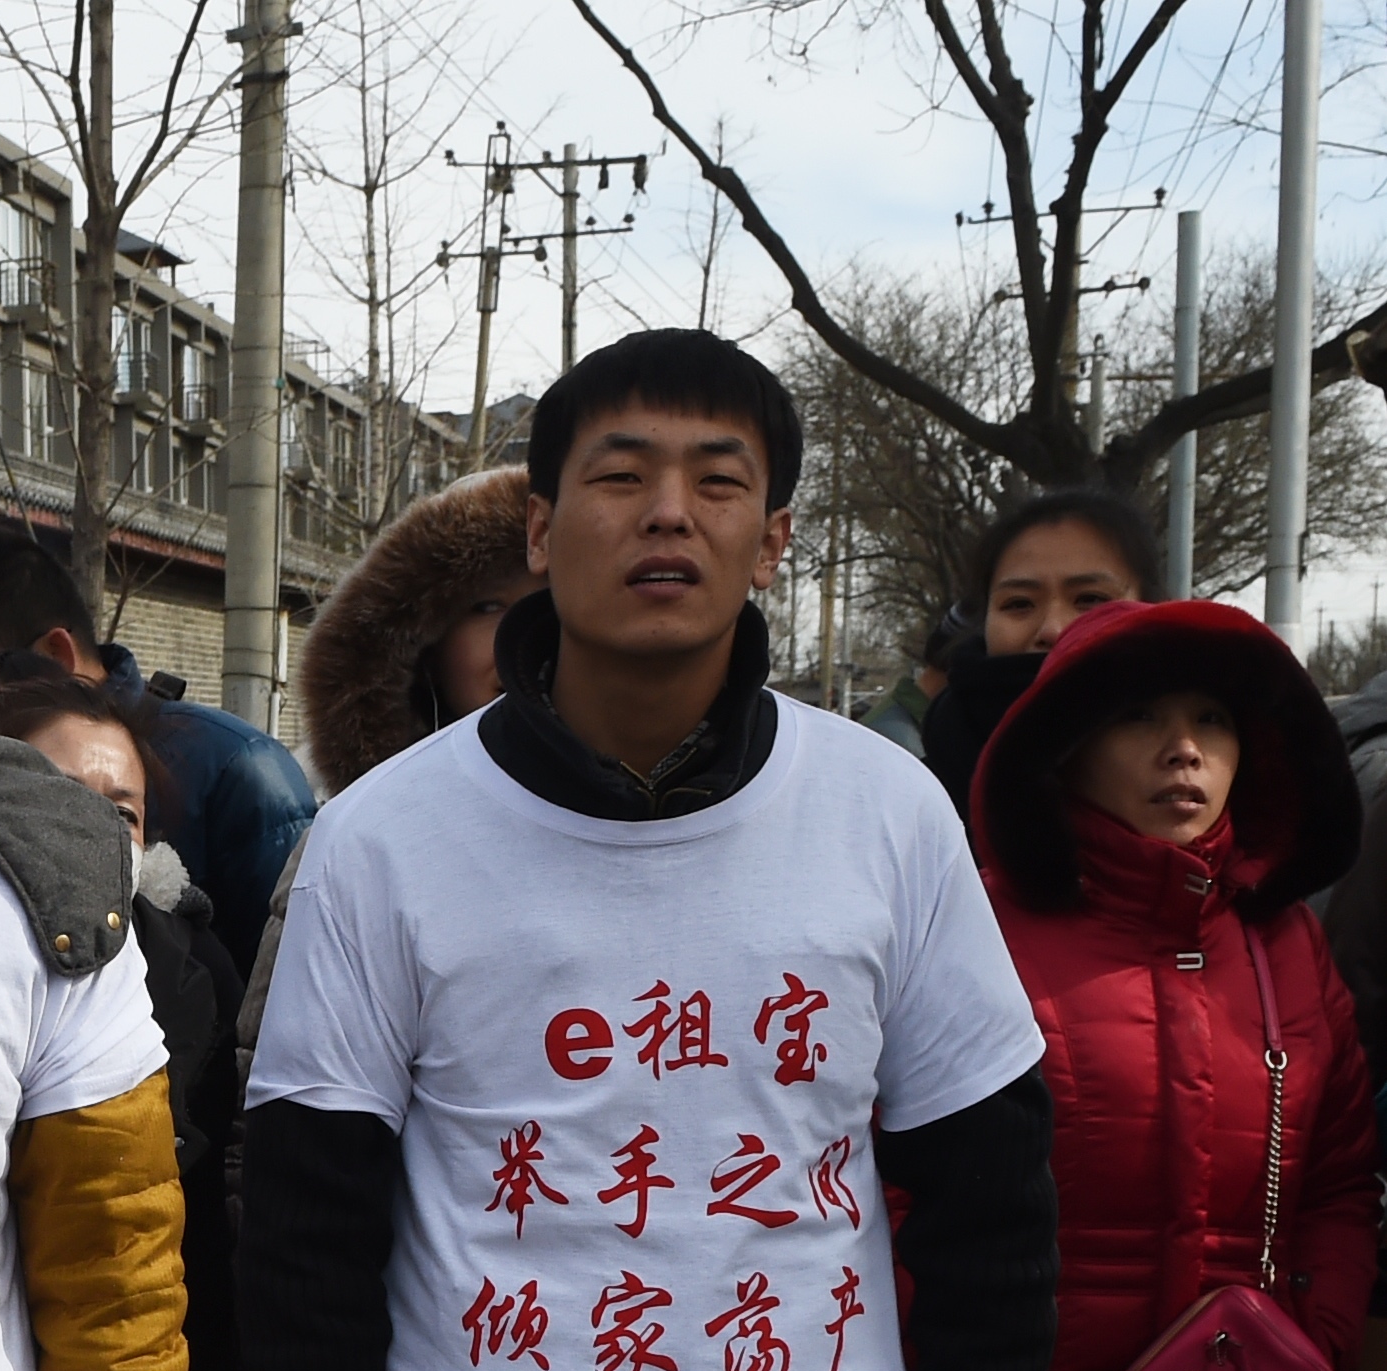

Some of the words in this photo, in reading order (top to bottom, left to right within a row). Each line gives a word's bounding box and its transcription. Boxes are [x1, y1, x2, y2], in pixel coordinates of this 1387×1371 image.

[543, 972, 829, 1086] e租宝
[483, 1120, 861, 1239] 举手之间
